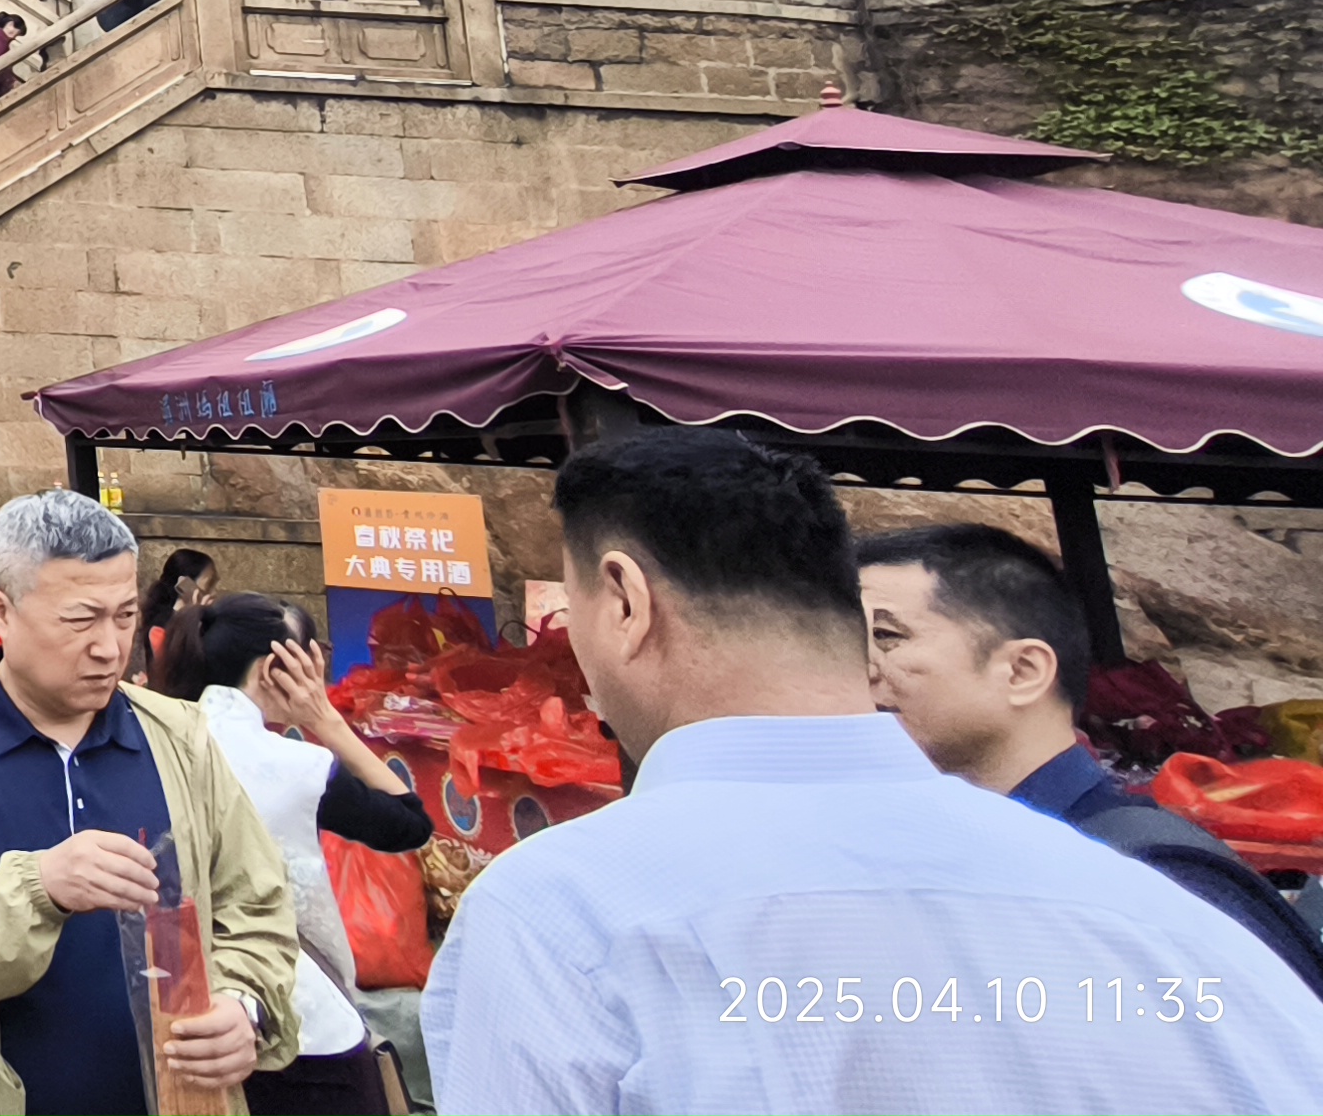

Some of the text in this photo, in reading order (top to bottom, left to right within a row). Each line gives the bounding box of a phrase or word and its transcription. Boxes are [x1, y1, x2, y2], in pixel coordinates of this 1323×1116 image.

[344, 554, 472, 585] 大典专用酒
